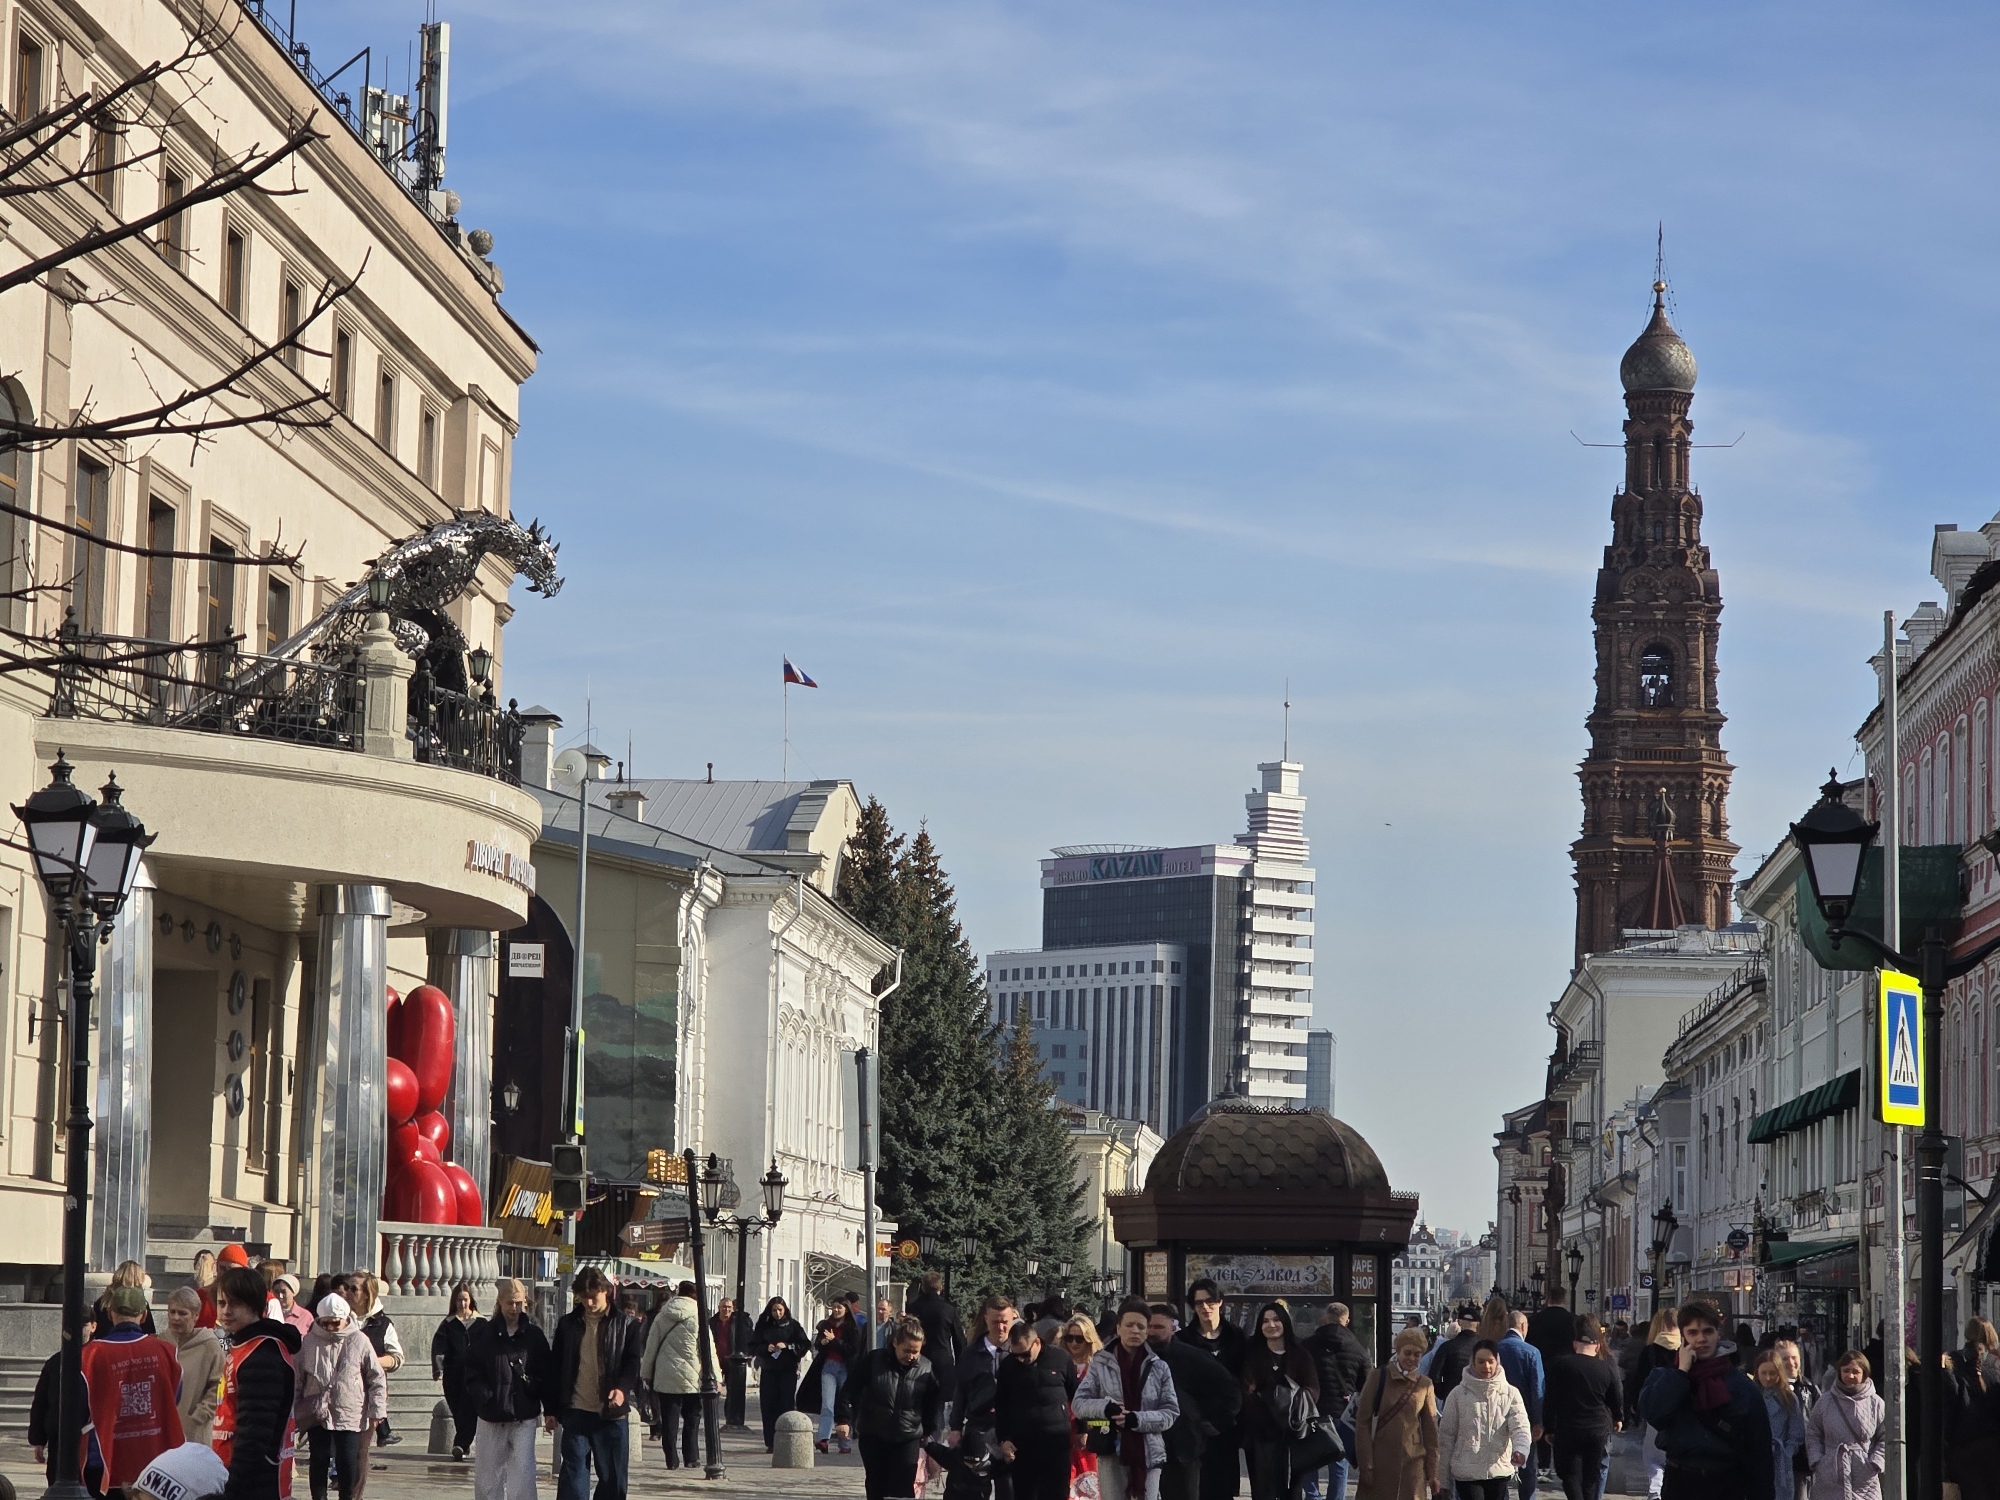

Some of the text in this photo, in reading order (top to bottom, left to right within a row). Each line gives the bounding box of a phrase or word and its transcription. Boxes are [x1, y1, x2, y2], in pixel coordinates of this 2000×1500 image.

[471, 840, 505, 876] ДВОРЕЦ
[1058, 853, 1194, 883] GRAND KAZAN HOTEL
[1304, 1265, 1319, 1283] 3
[1352, 1260, 1373, 1273] VAPE
[1352, 1276, 1374, 1290] SHOP
[142, 1470, 182, 1500] SWAG
